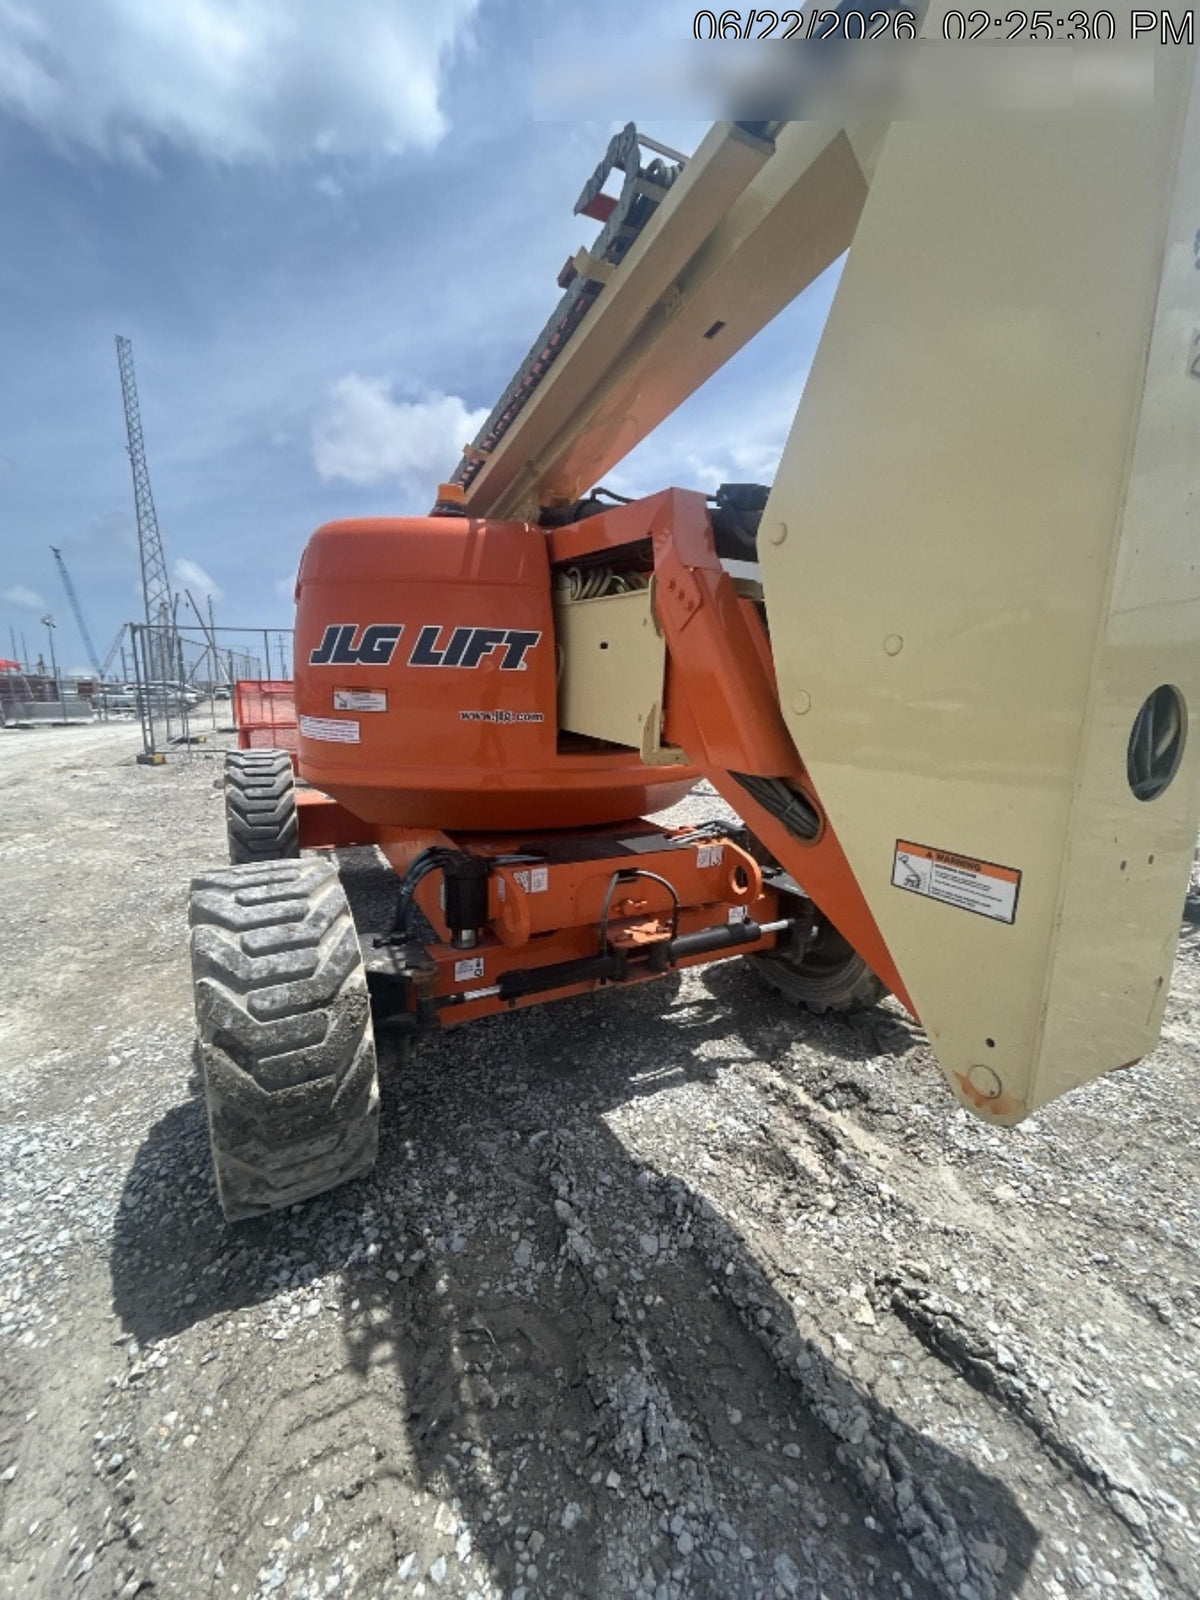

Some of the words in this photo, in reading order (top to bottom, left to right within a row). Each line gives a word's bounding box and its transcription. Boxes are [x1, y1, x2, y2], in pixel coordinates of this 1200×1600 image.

[309, 623, 405, 666] JLG
[407, 625, 543, 671] LIFT
[459, 709, 544, 723] www.jlg.com
[935, 851, 982, 872] WARNING
